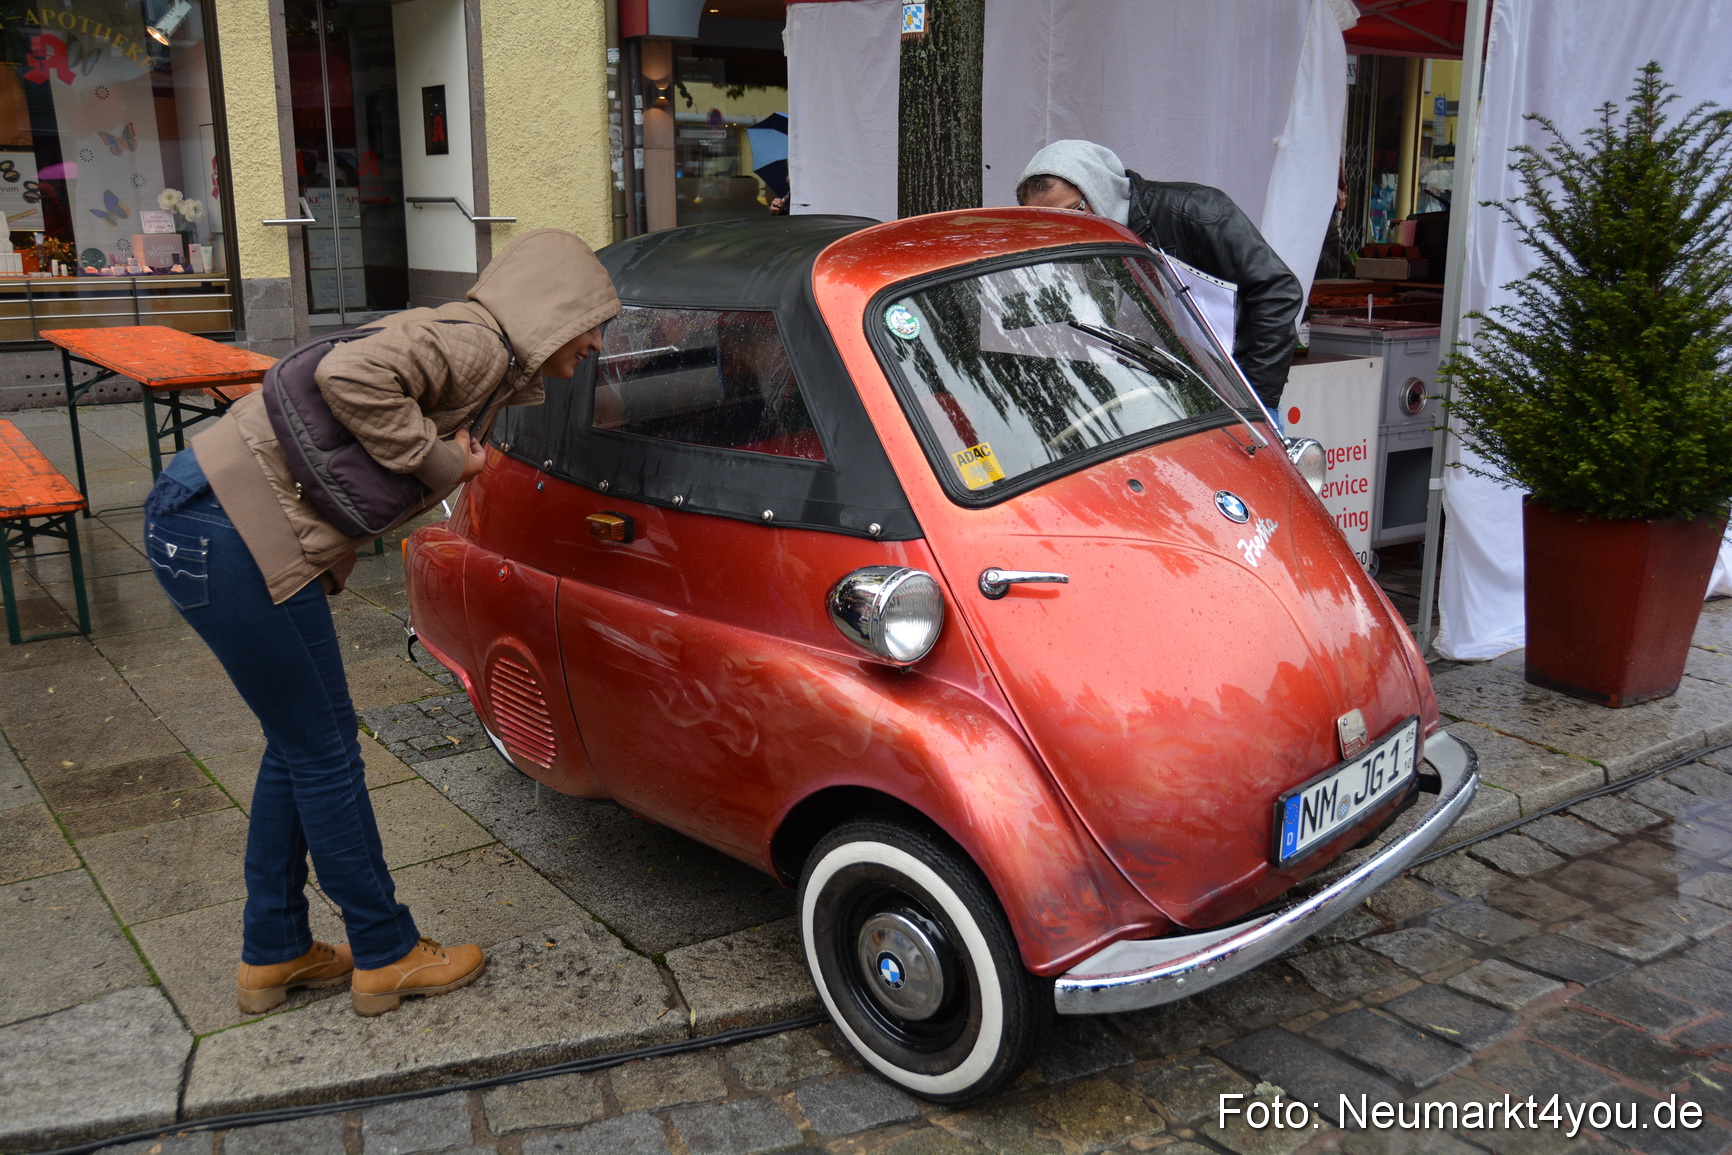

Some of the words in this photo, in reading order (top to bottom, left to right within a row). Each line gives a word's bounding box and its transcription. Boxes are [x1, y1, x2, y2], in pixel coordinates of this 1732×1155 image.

[956, 444, 991, 467] ADAC
[1324, 439, 1367, 470] gerei
[1321, 474, 1368, 499] ervice
[1331, 507, 1369, 532] ring
[1300, 778, 1339, 840] NM
[1286, 831, 1294, 847] D
